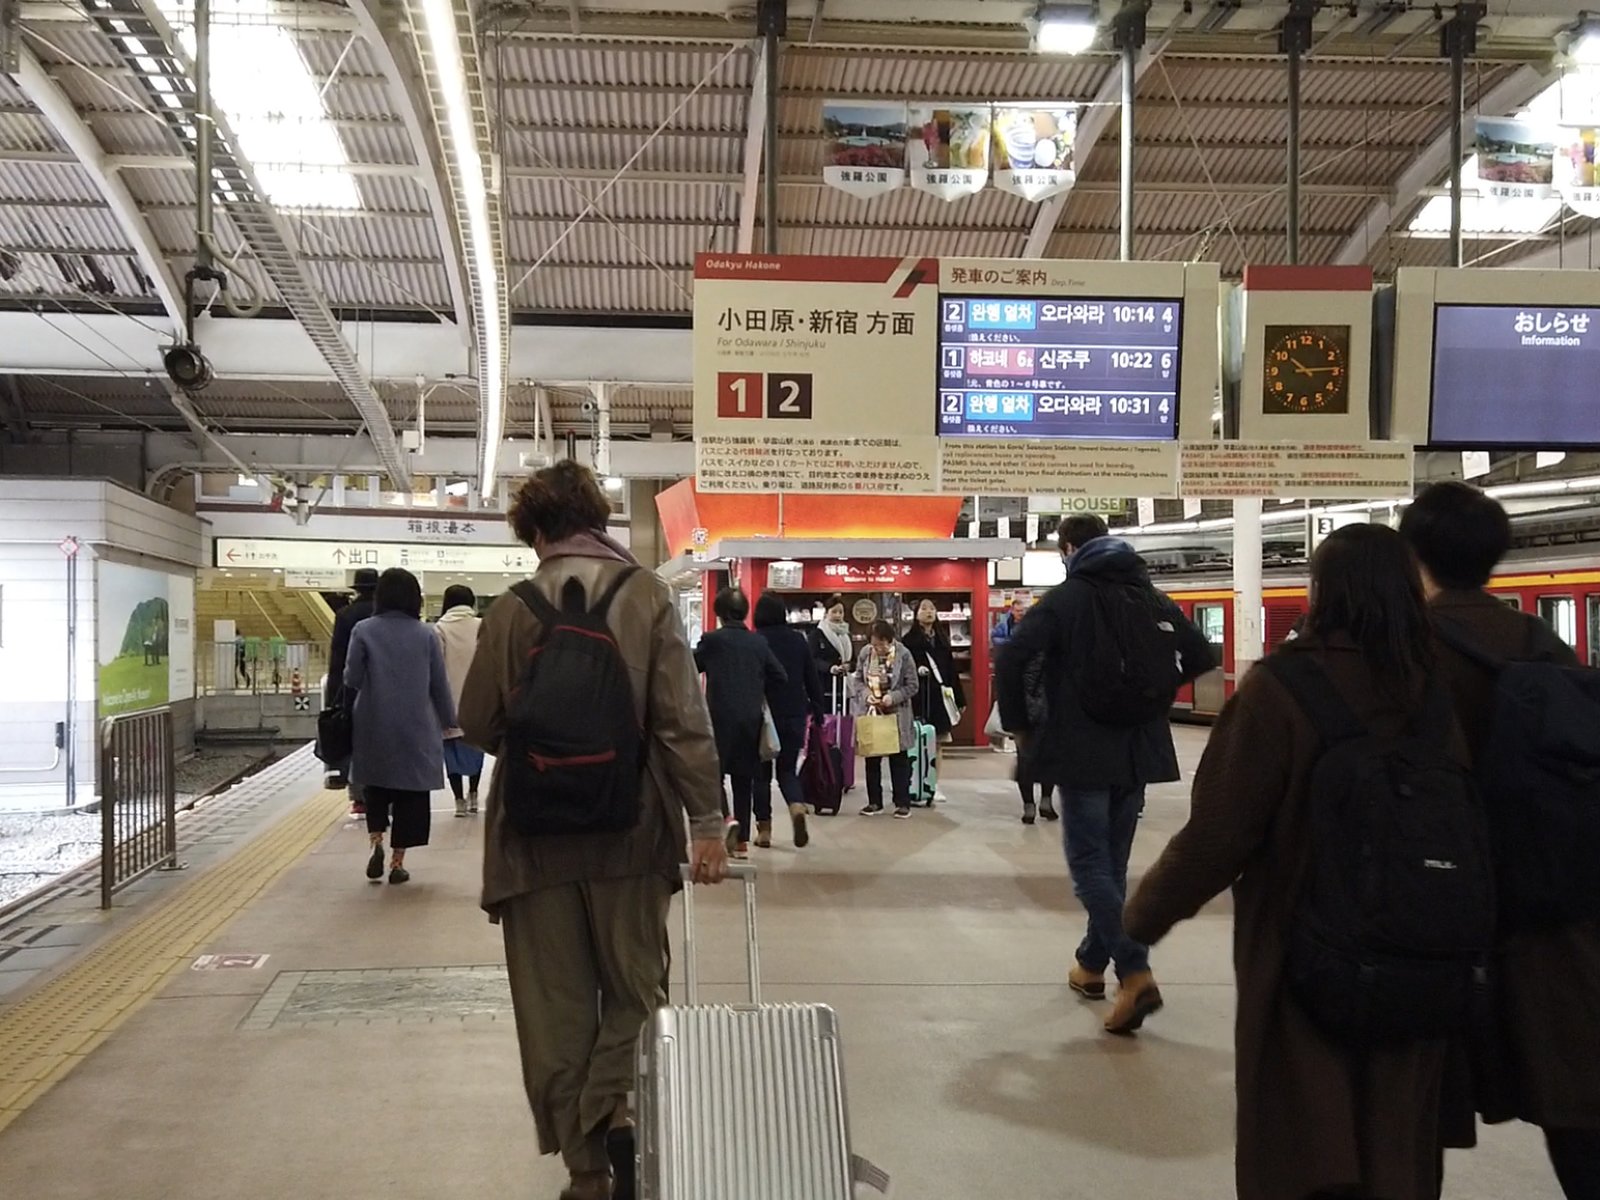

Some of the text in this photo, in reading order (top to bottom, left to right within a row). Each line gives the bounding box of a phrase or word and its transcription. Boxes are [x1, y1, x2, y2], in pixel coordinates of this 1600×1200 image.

[841, 170, 888, 183] 強羅公園
[926, 173, 973, 185] 強羅公園
[706, 259, 781, 270] Odakyu Hakone
[951, 267, 1047, 286] 発車のご案内
[948, 303, 961, 321] 2
[972, 303, 1173, 325] 완행 열차 오다와라 10:14 4
[717, 307, 916, 336] 小田原・新宿 方面
[1513, 311, 1591, 334] おしらせ
[717, 337, 732, 347] For
[734, 338, 778, 348] Odawara
[785, 339, 827, 351] Shinjuku
[1286, 340, 1297, 349] 11
[1300, 335, 1313, 345] 12
[1318, 340, 1324, 350] 1
[1521, 334, 1581, 346] Information
[948, 350, 957, 366] 1
[969, 348, 1008, 368] 하코네
[1040, 349, 1091, 369] 신주쿠
[1111, 352, 1153, 369] 10:22
[1161, 353, 1172, 369] 6
[1275, 351, 1288, 361] 10
[1327, 351, 1336, 361] 2
[1271, 366, 1279, 376] 9
[1275, 381, 1284, 391] 8
[1325, 381, 1334, 391] 4
[729, 378, 801, 413] 1 2
[1286, 393, 1294, 402] 7
[1300, 396, 1308, 406] 6
[1315, 392, 1323, 402] 5
[946, 395, 958, 412] 2
[969, 394, 1170, 416] 완행 열차 오다와라 10:31 4
[1060, 497, 1119, 511] HOUSE
[407, 519, 477, 534] 箱根湯本
[1320, 519, 1332, 534] 3
[348, 547, 378, 565] 出口
